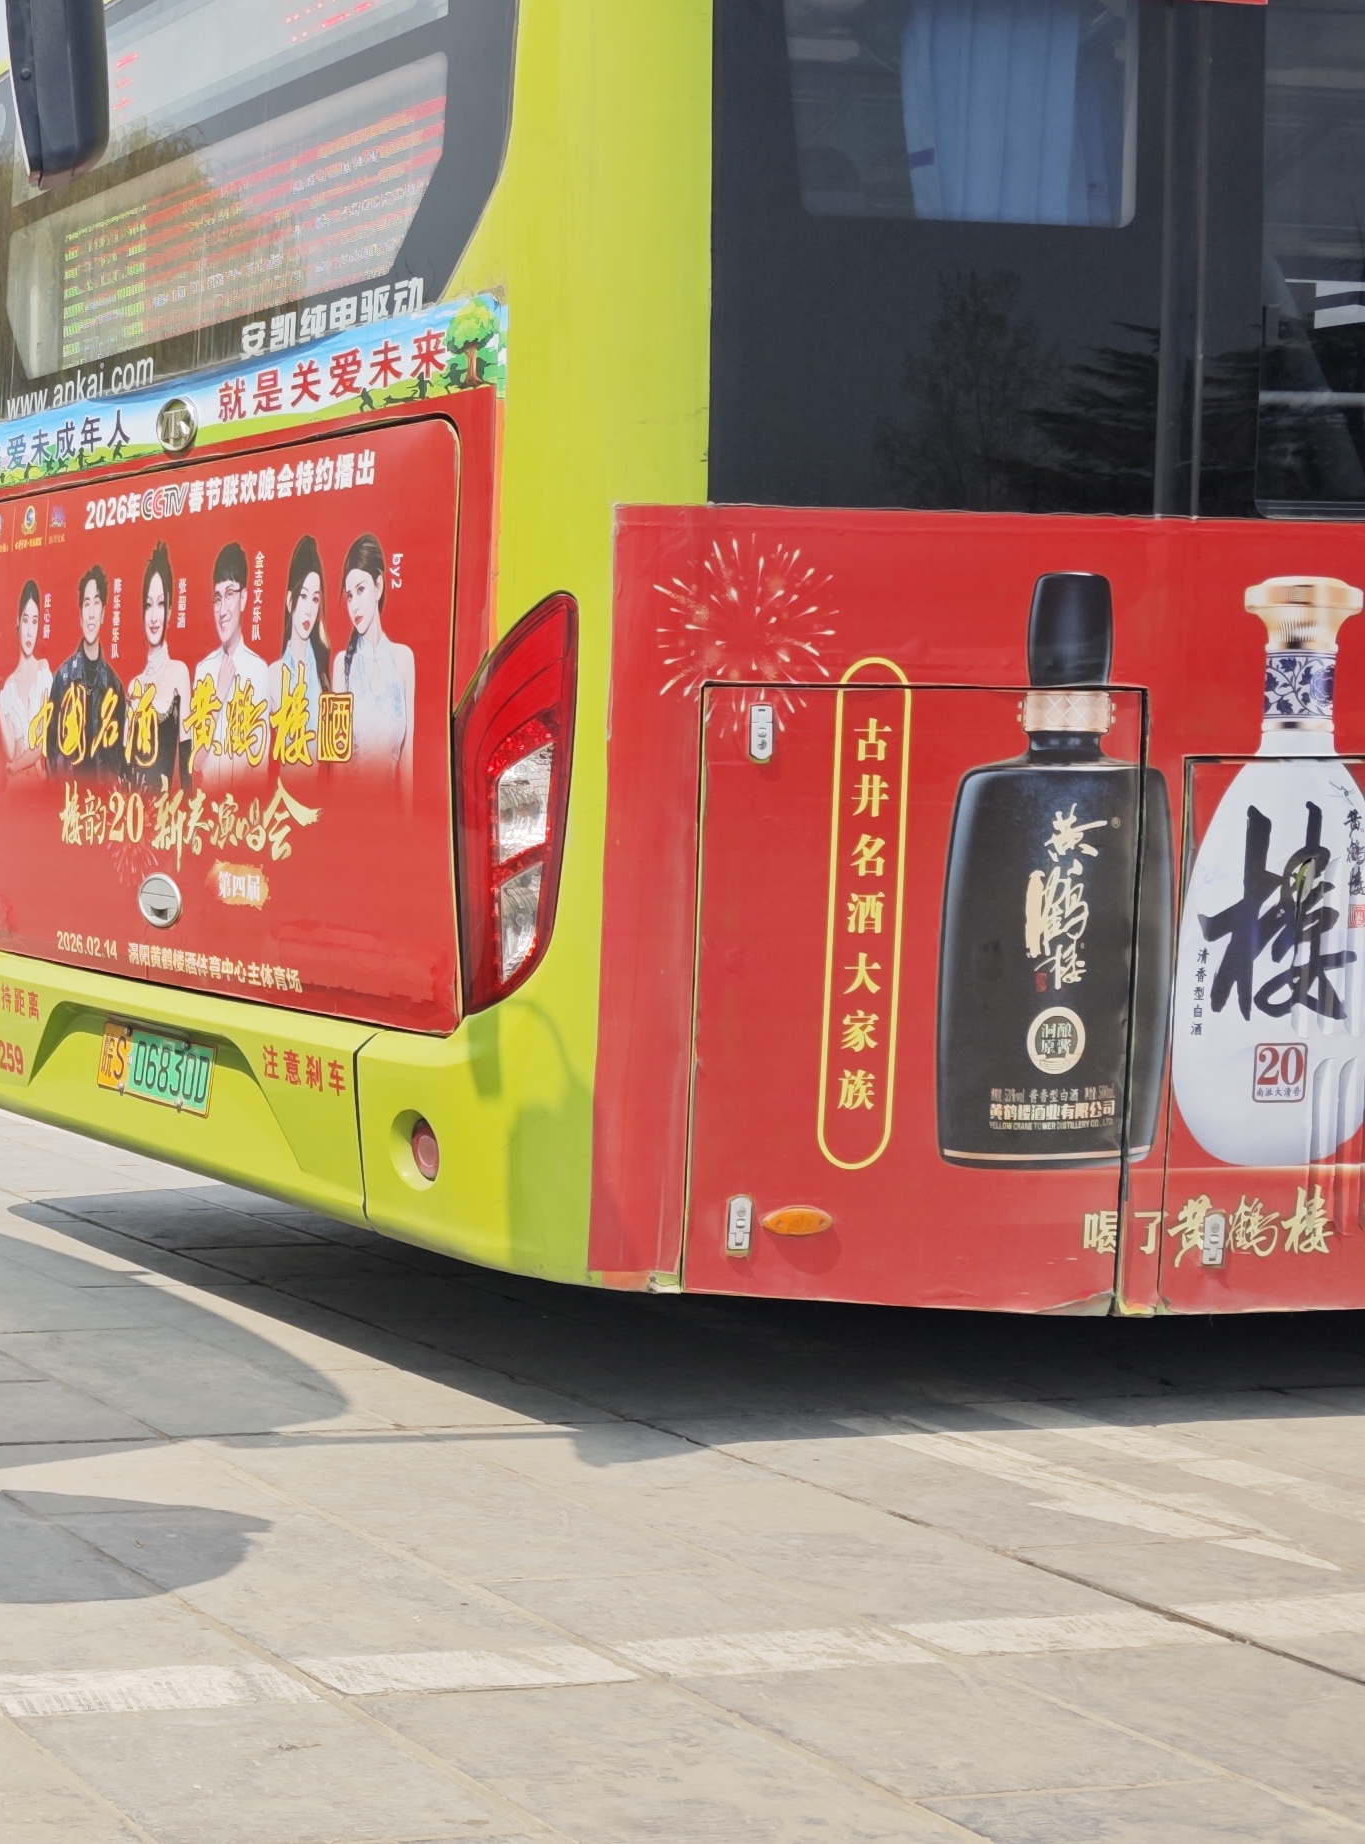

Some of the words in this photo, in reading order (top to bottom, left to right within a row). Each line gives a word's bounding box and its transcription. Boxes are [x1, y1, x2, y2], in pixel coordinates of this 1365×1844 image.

[240, 277, 424, 360] 安凯纯电驱动
[6, 355, 155, 420] www.ankai.com
[218, 329, 447, 420] 就是关爱未来
[218, 871, 261, 902] 第四届
[837, 718, 892, 1111] 古井名酒大家族
[57, 931, 118, 960] 2026.02.14
[1190, 948, 1211, 1036] 清香型白酒
[262, 1044, 347, 1096] 注意刹车
[1257, 1046, 1304, 1086] 20
